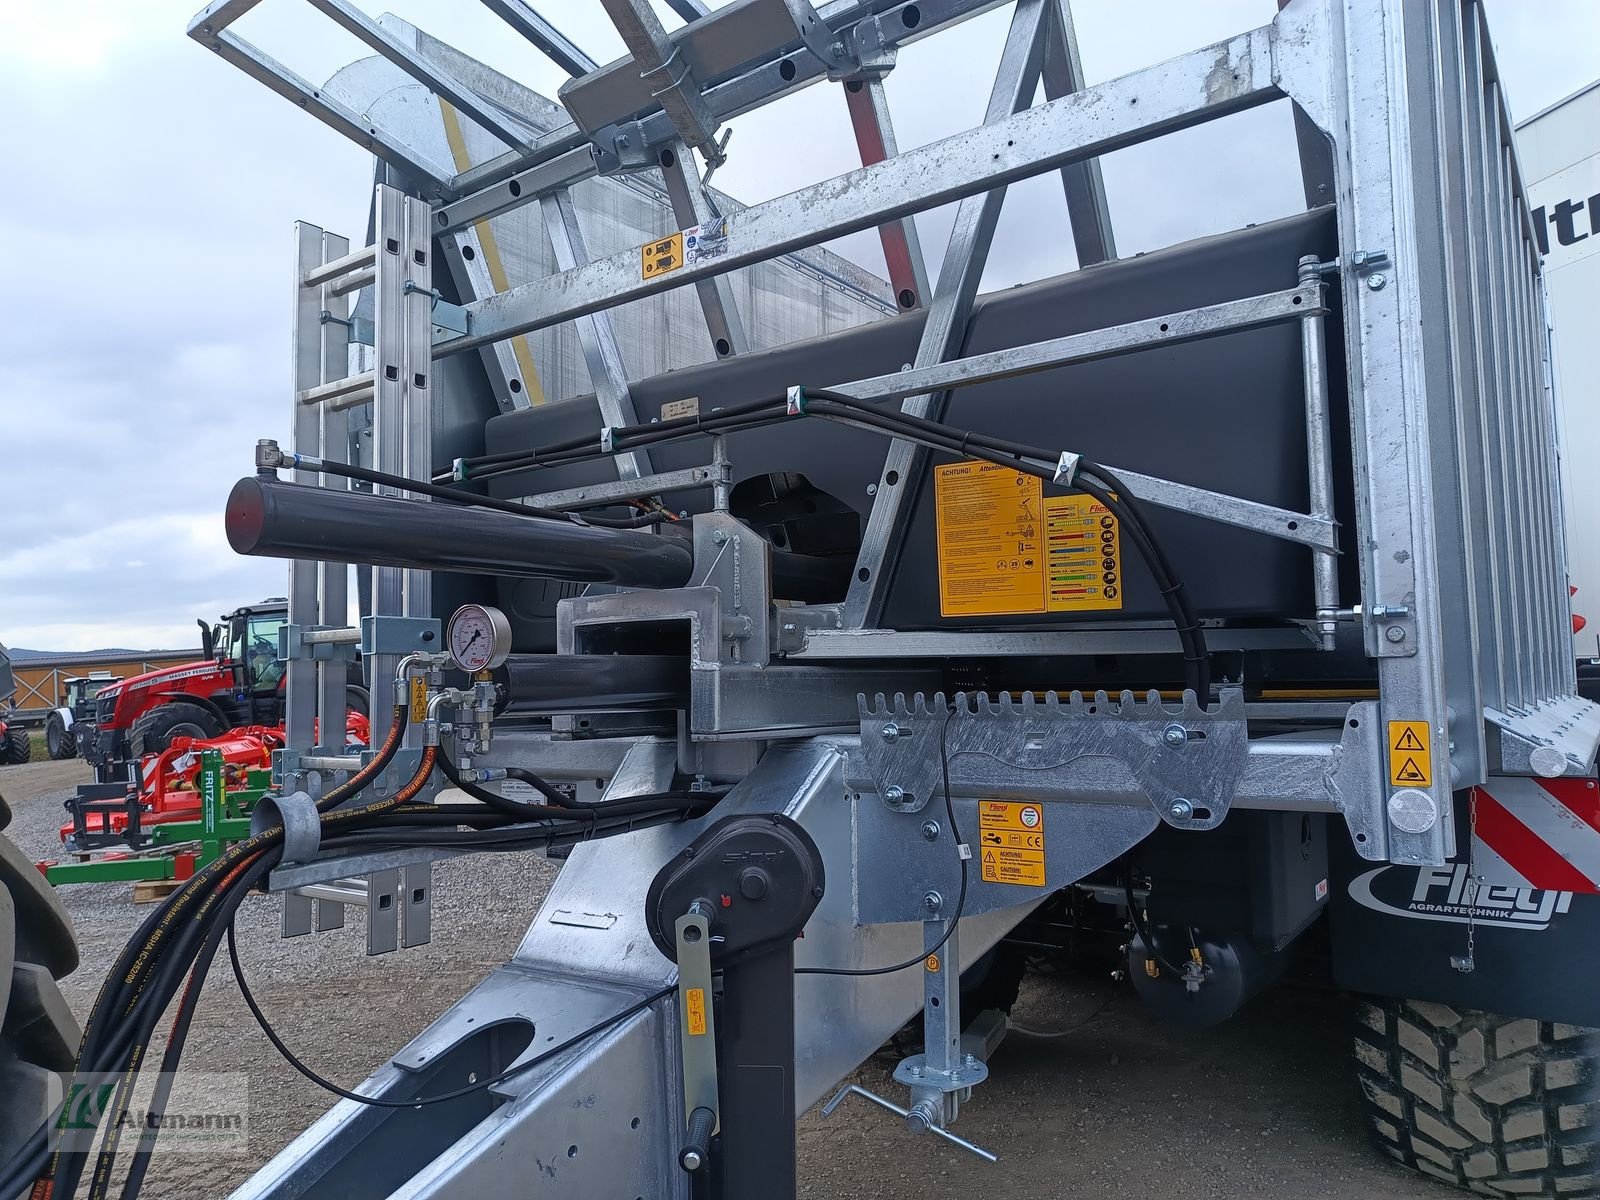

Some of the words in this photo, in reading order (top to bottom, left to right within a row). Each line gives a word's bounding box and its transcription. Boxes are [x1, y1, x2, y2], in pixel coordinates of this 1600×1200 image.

[941, 467, 972, 477] ACHTUNG!
[168, 671, 191, 680] MASSEY
[192, 666, 218, 675] FERGUSO
[414, 759, 434, 786] PREMIUM
[205, 770, 214, 802] FRITZ
[367, 798, 395, 812] EXCEEDS
[229, 847, 242, 859] WP
[187, 875, 208, 895] Flame
[163, 894, 191, 926] Resistant
[1408, 902, 1511, 919] AGRARTECHNIK
[144, 928, 164, 952] MSHA
[125, 949, 149, 985] IC-252/00
